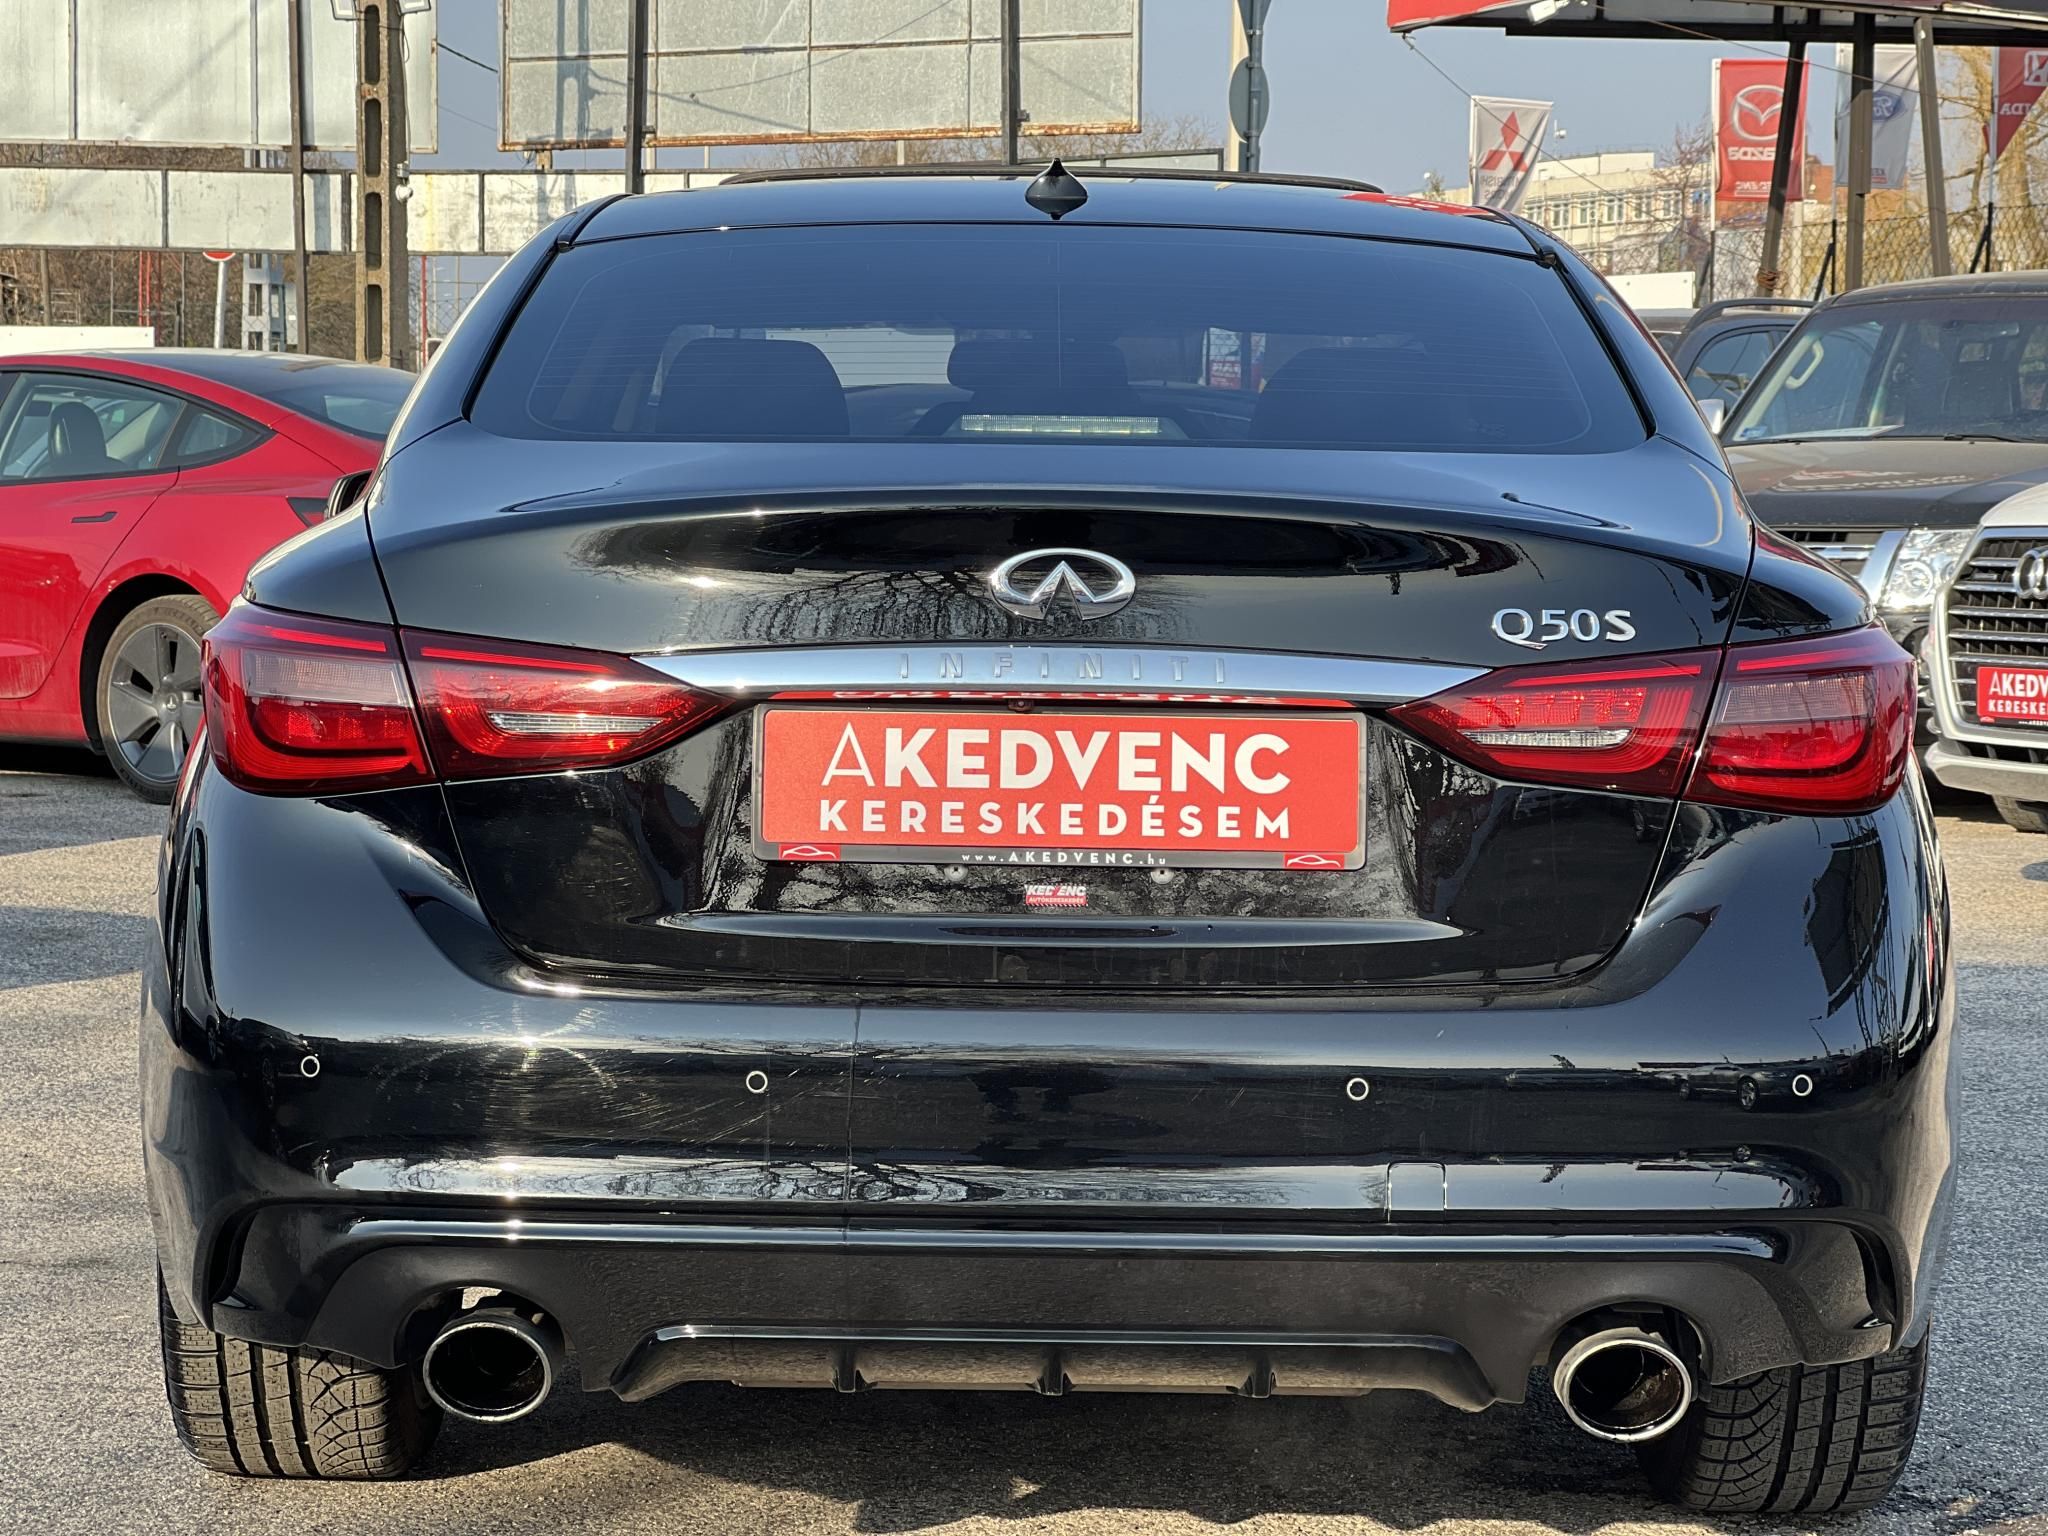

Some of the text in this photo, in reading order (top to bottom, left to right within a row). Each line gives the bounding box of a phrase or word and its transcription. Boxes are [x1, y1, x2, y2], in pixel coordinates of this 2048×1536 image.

[1491, 608, 1636, 650] Q50S
[901, 652, 1225, 684] INFINITI
[821, 722, 1291, 794] AKEDVENC
[820, 795, 1290, 839] KERESKEDÉSEM
[961, 851, 1166, 866] www.AKEDVENC.hu
